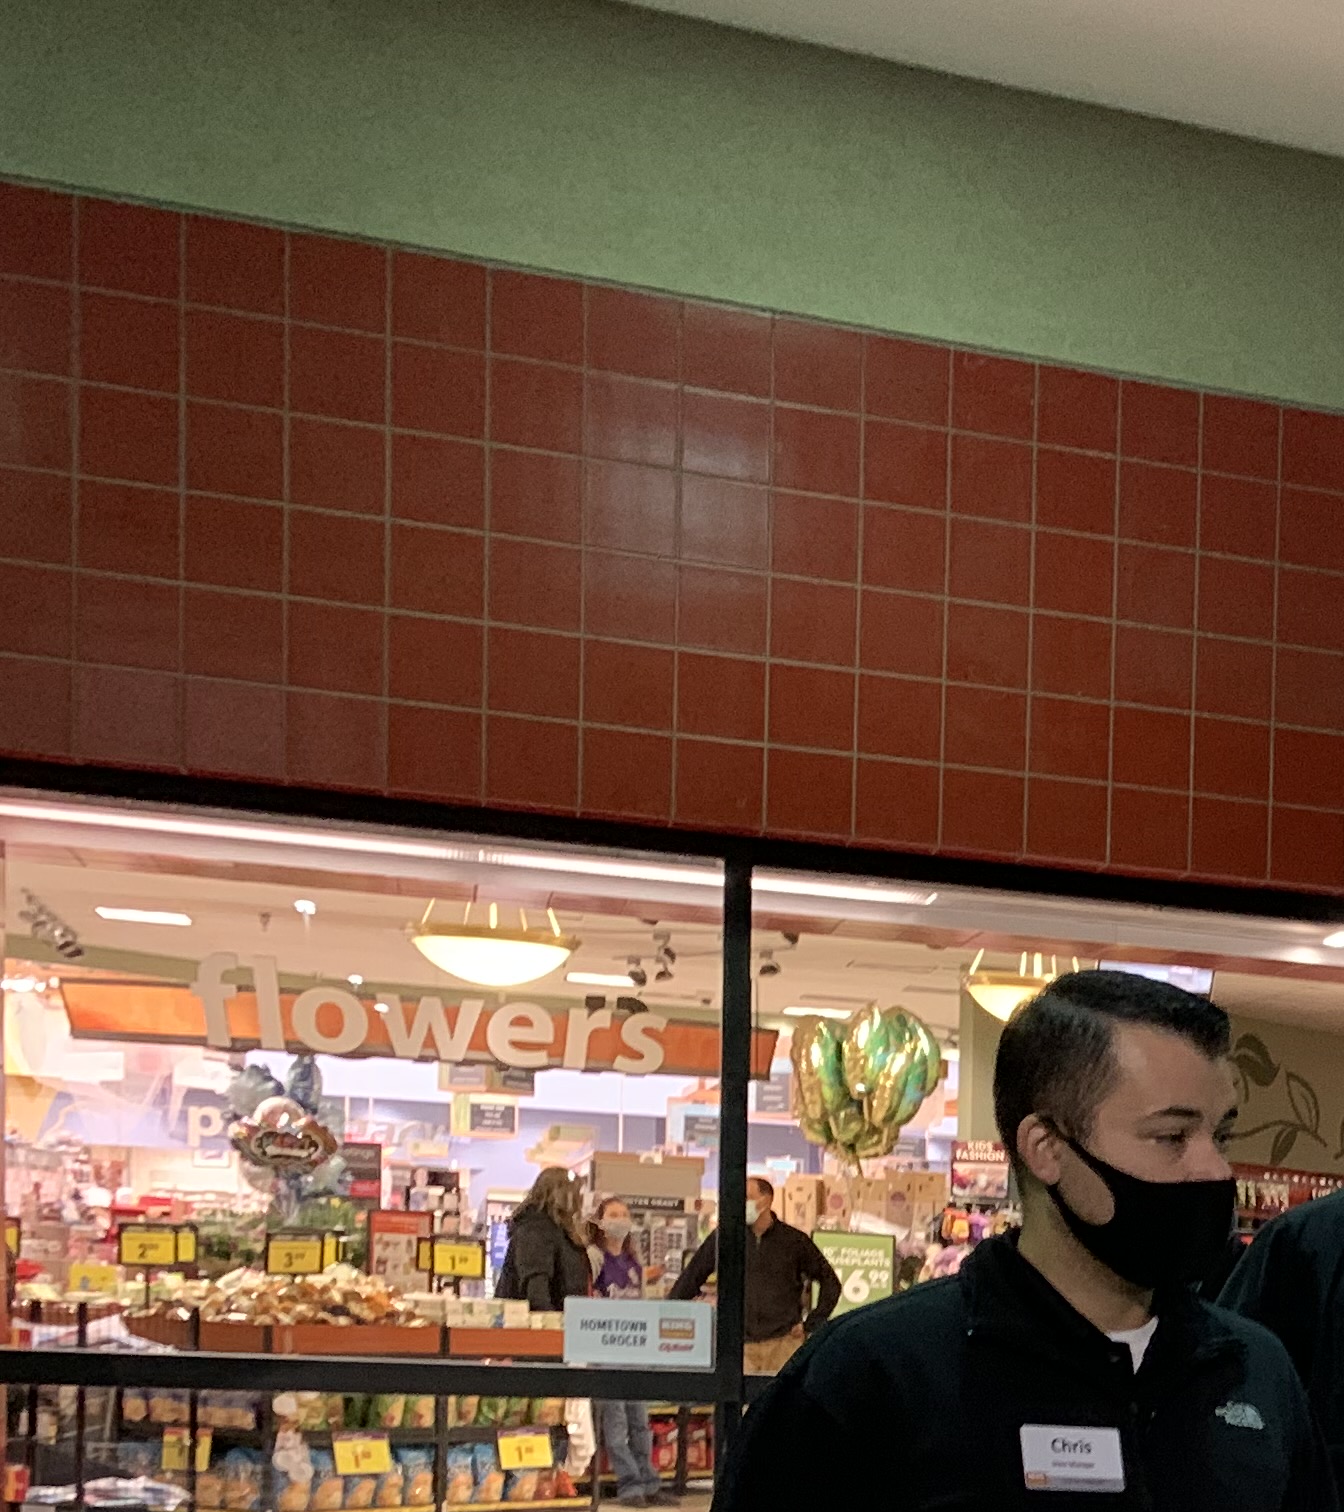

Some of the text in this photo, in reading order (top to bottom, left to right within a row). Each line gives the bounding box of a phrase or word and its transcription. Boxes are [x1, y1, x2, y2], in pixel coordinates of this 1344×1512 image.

[191, 951, 668, 1074] flowers
[967, 1140, 994, 1151] KIDS
[955, 1149, 1006, 1162] FASHION
[580, 1318, 648, 1333] HOMETOWN
[600, 1334, 648, 1347] GROCER
[1050, 1437, 1092, 1456] Chris
